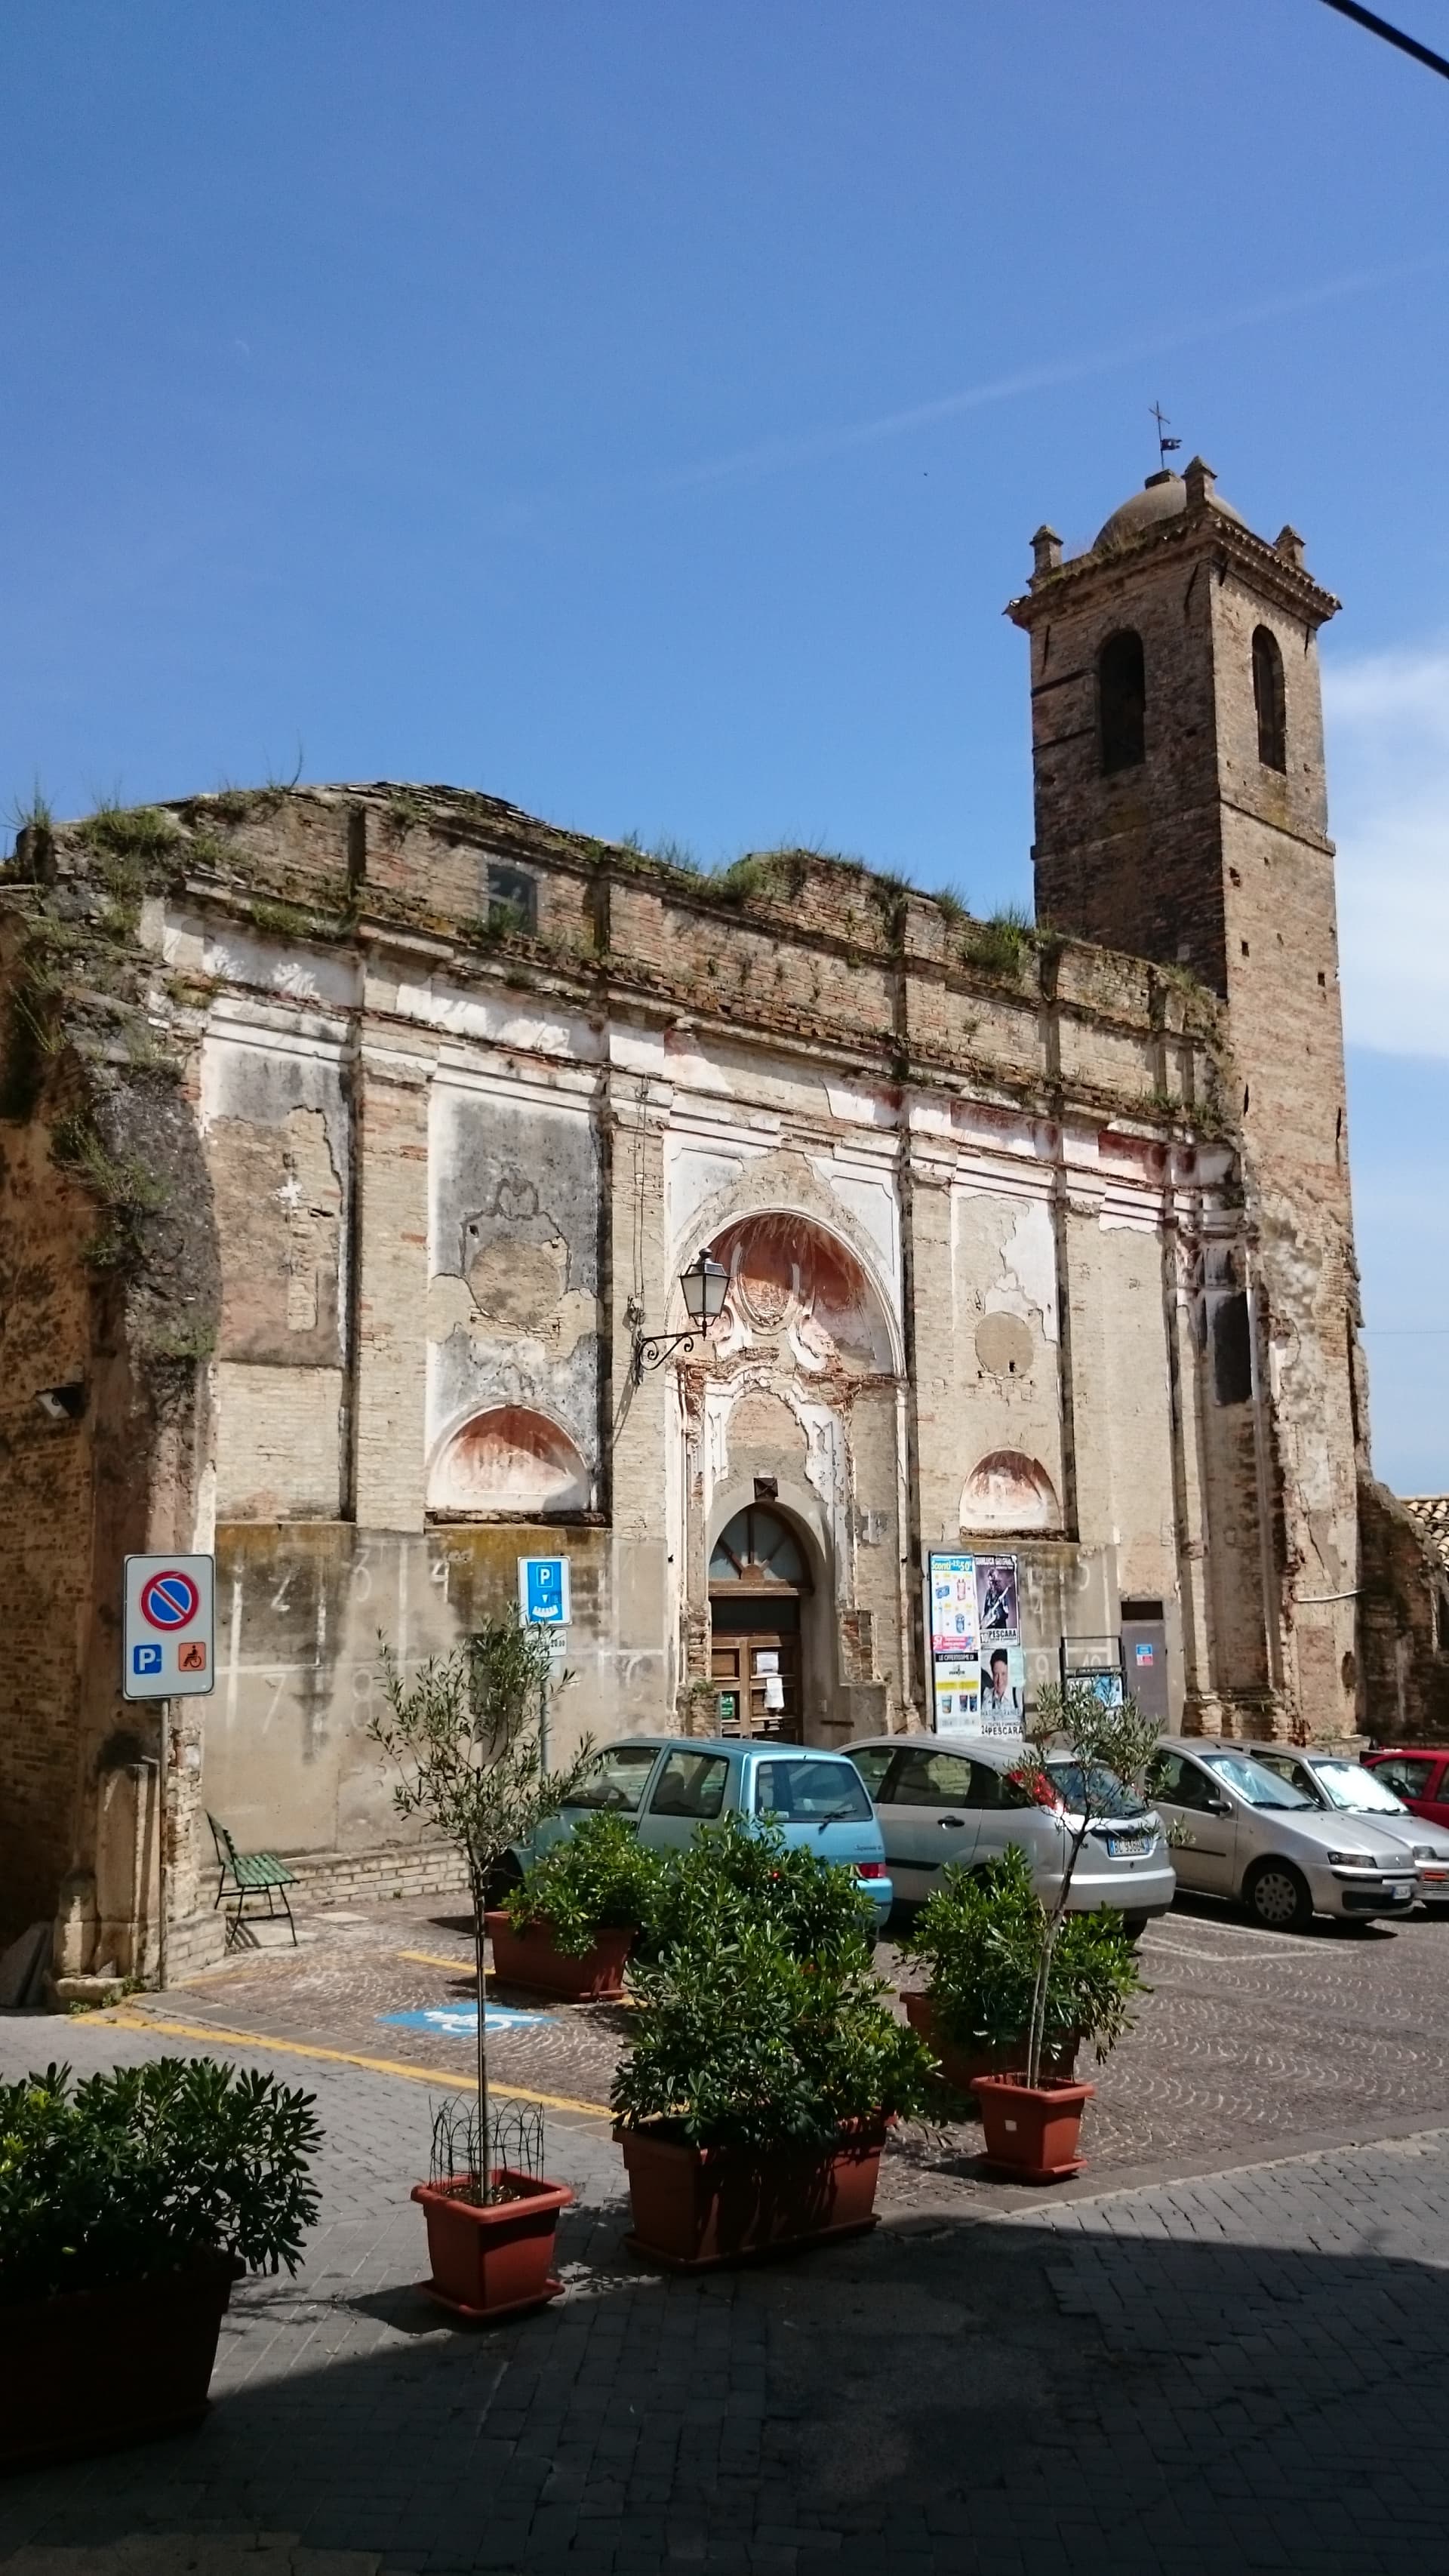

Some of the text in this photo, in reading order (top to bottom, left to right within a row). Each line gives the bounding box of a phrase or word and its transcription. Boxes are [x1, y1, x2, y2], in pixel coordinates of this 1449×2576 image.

[931, 1560, 951, 1570] Sconti
[540, 1568, 550, 1585] P
[980, 1633, 989, 1643] 10
[989, 1630, 1017, 1638] PESCARA
[139, 1648, 155, 1671] P
[981, 1725, 1024, 1735] 24 PESCARA
